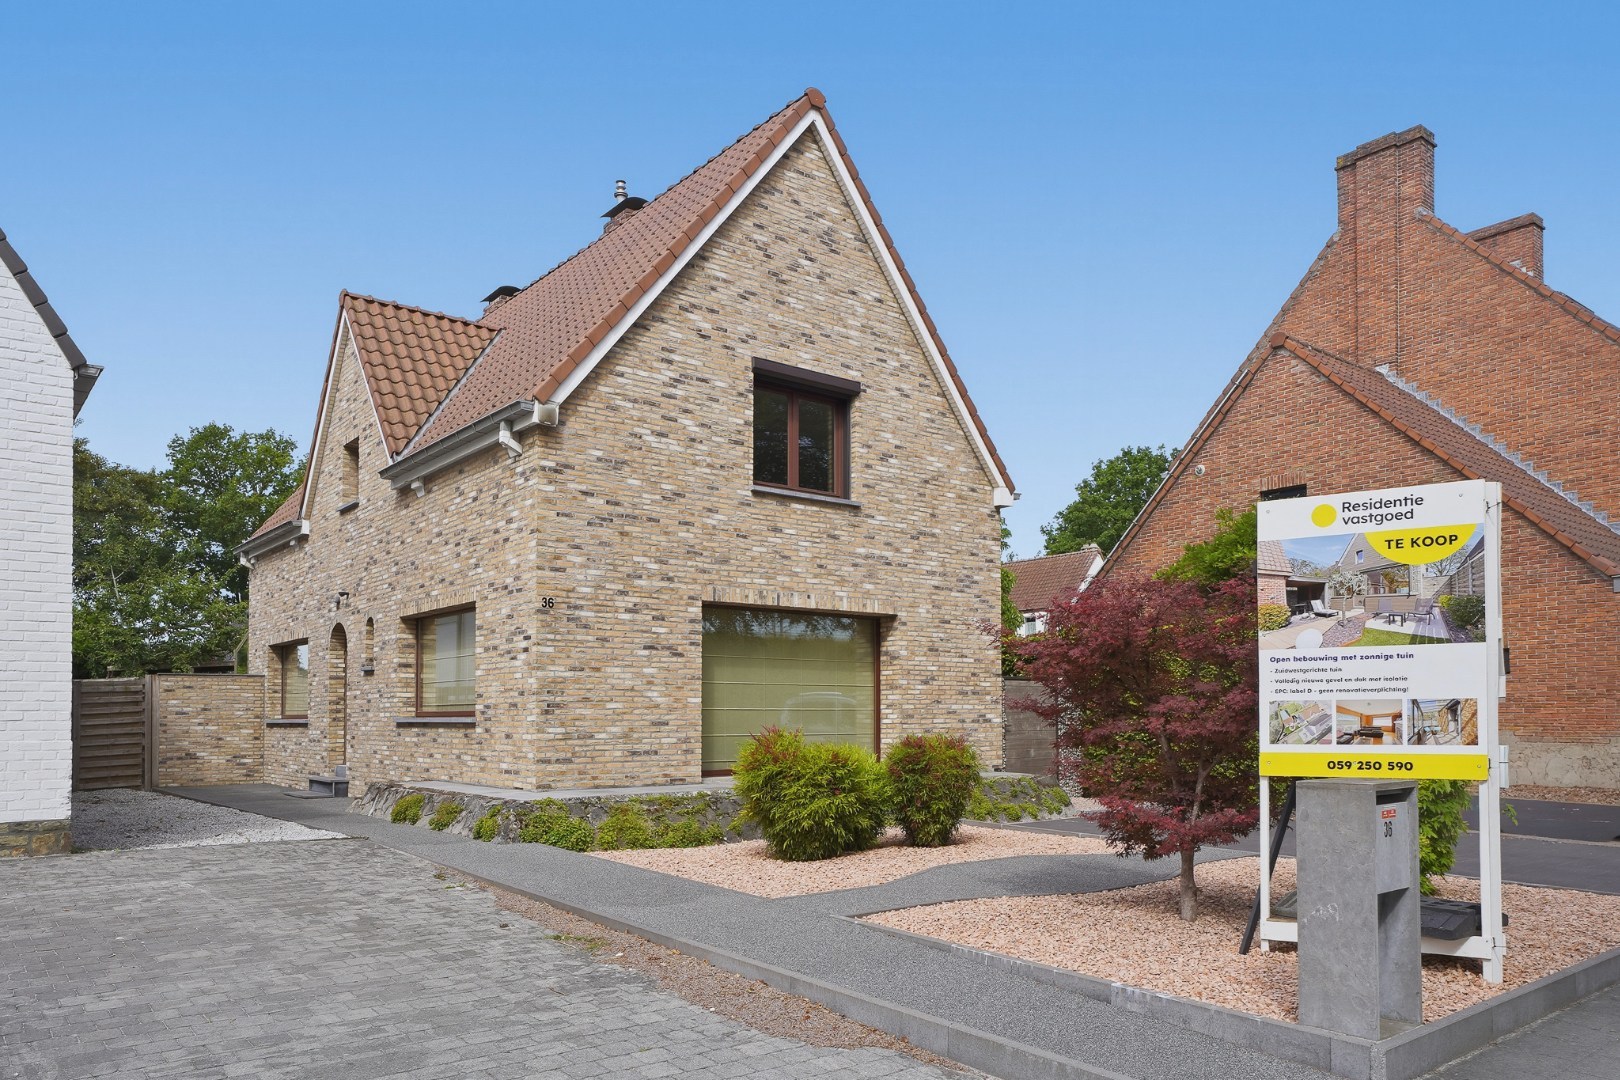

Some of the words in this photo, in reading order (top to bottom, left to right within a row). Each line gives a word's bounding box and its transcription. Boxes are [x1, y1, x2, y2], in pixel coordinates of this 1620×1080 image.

[1342, 494, 1424, 513] Residentie
[1342, 508, 1414, 526] vastgoed
[1385, 538, 1404, 550] TE
[1410, 534, 1458, 549] KOOP
[541, 596, 555, 609] 36
[1269, 656, 1291, 664] Open
[1293, 654, 1338, 663] bebouwing
[1360, 652, 1394, 661] zonnige
[1327, 760, 1352, 770] 059
[1356, 760, 1382, 771] 250
[1387, 761, 1414, 771] 590
[1383, 820, 1393, 838] 36
